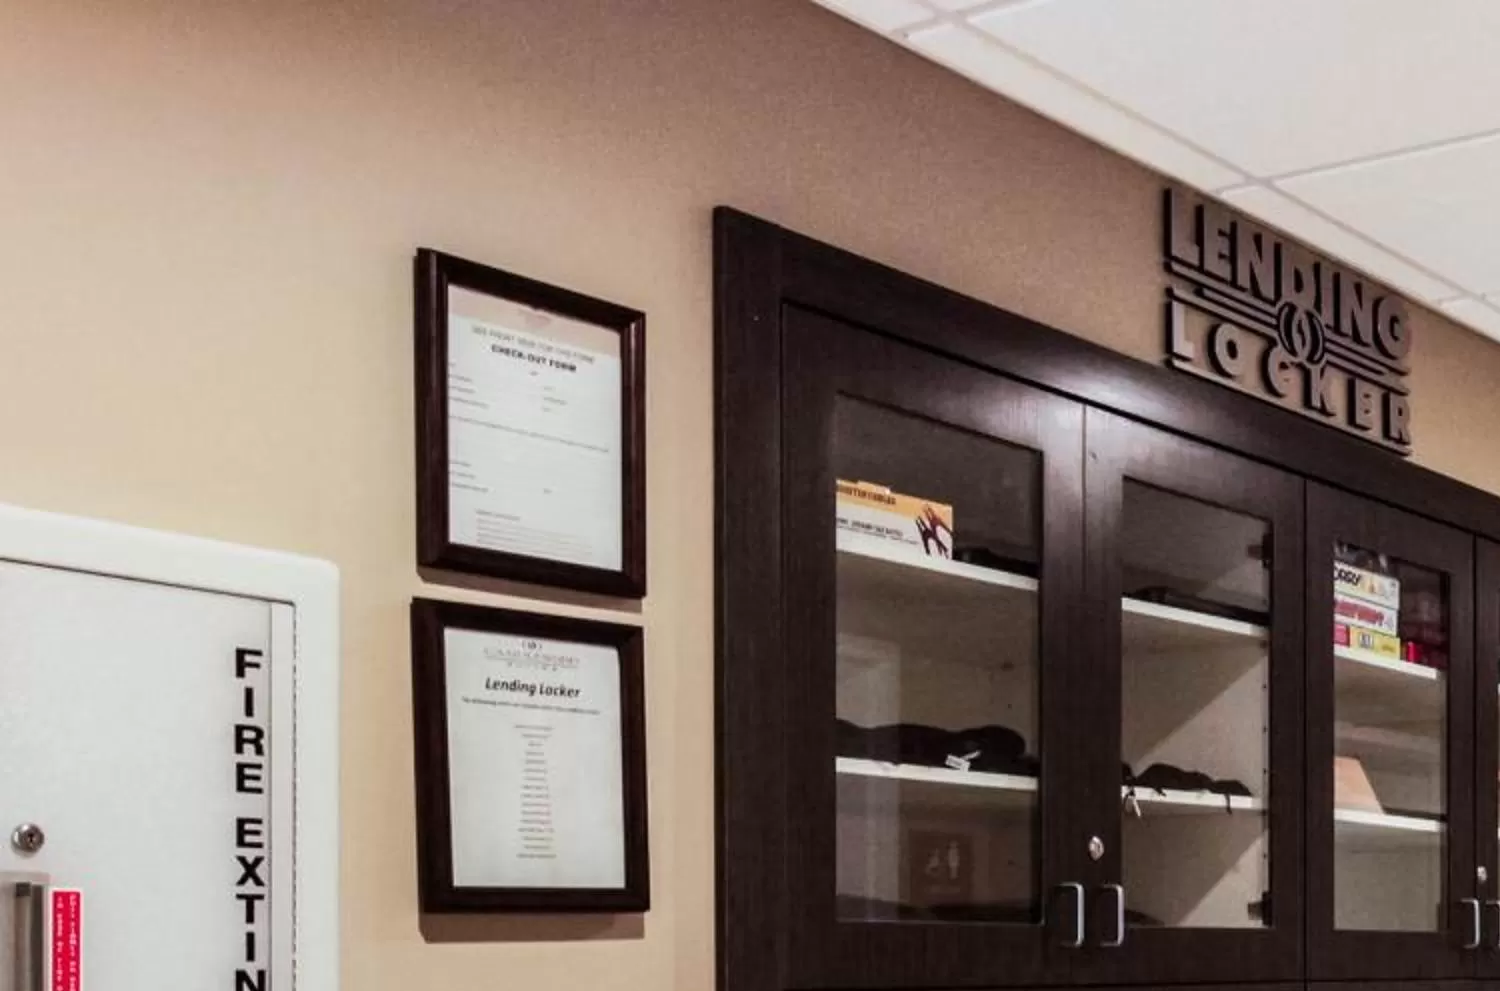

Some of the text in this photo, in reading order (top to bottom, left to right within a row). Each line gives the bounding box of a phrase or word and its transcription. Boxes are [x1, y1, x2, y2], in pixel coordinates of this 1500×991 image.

[1164, 187, 1410, 361] LENDING
[548, 358, 577, 373] FORM
[1165, 298, 1412, 446] LOCKER
[235, 648, 265, 794] FIRE
[484, 677, 582, 699] Lending Locker
